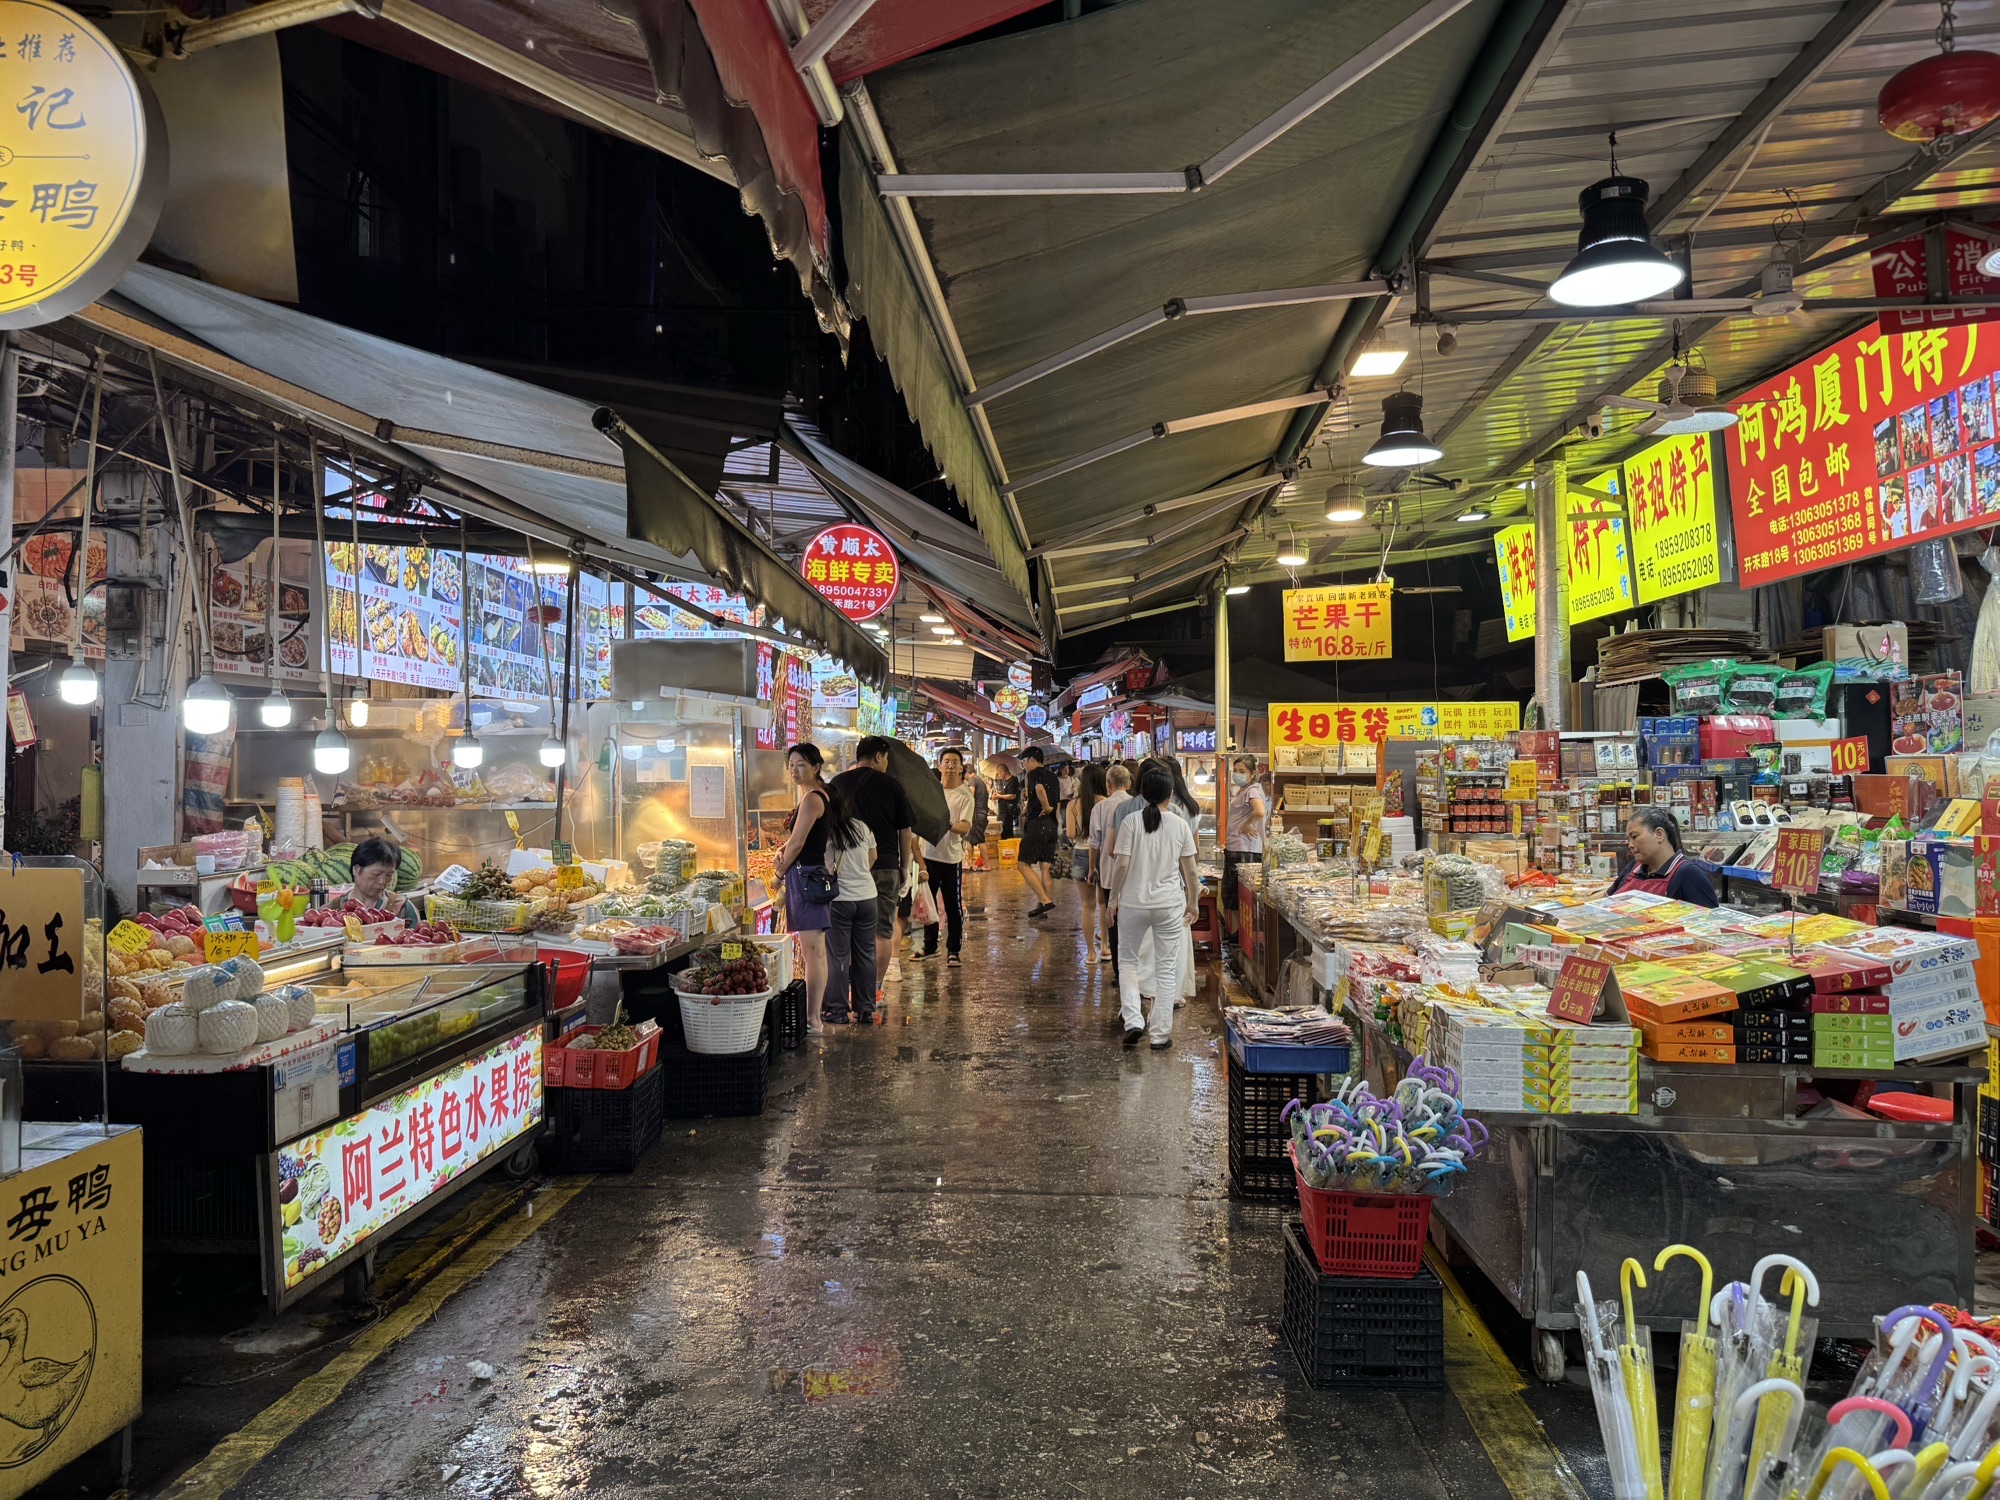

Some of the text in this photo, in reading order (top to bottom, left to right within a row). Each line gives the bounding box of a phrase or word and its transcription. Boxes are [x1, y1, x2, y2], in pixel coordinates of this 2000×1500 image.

[16, 86, 87, 131] 记
[1628, 434, 1710, 535] 游姐特产
[1746, 441, 1851, 518] 全国包邮
[1769, 490, 1860, 535] 电话:13063051378
[1864, 486, 1877, 545] 微信同号
[819, 535, 882, 557] 黄顺太
[1655, 522, 1712, 559] 18959208378
[1791, 513, 1863, 547] 13063051368
[1657, 553, 1714, 589] 18965852098
[1743, 534, 1864, 574] 开禾路18号 13063051369
[806, 558, 894, 585] 海鲜专卖
[828, 599, 877, 611] 禾路21号
[1286, 590, 1388, 604] 厂家直销 回馈新老顾客
[1292, 602, 1382, 630] 芒果干
[1288, 635, 1387, 657] 特价16.8元/斤
[1276, 706, 1390, 744] 生日盲袋
[1399, 724, 1434, 735] 15元/袋
[1443, 708, 1513, 717] 玩偶 挂件 玩具
[1443, 719, 1513, 729] 摆件 饰品 乐高
[1832, 741, 1857, 771] 10
[1777, 832, 1823, 852] 厂家直销
[1775, 852, 1787, 885] 特价
[1786, 852, 1808, 887] 10
[1567, 962, 1601, 980] 厂家直销
[341, 1050, 532, 1225] 阿兰特色水果捞
[7, 1163, 112, 1242] 母鸭
[33, 1229, 69, 1265] MU
[77, 1214, 108, 1241] YA
